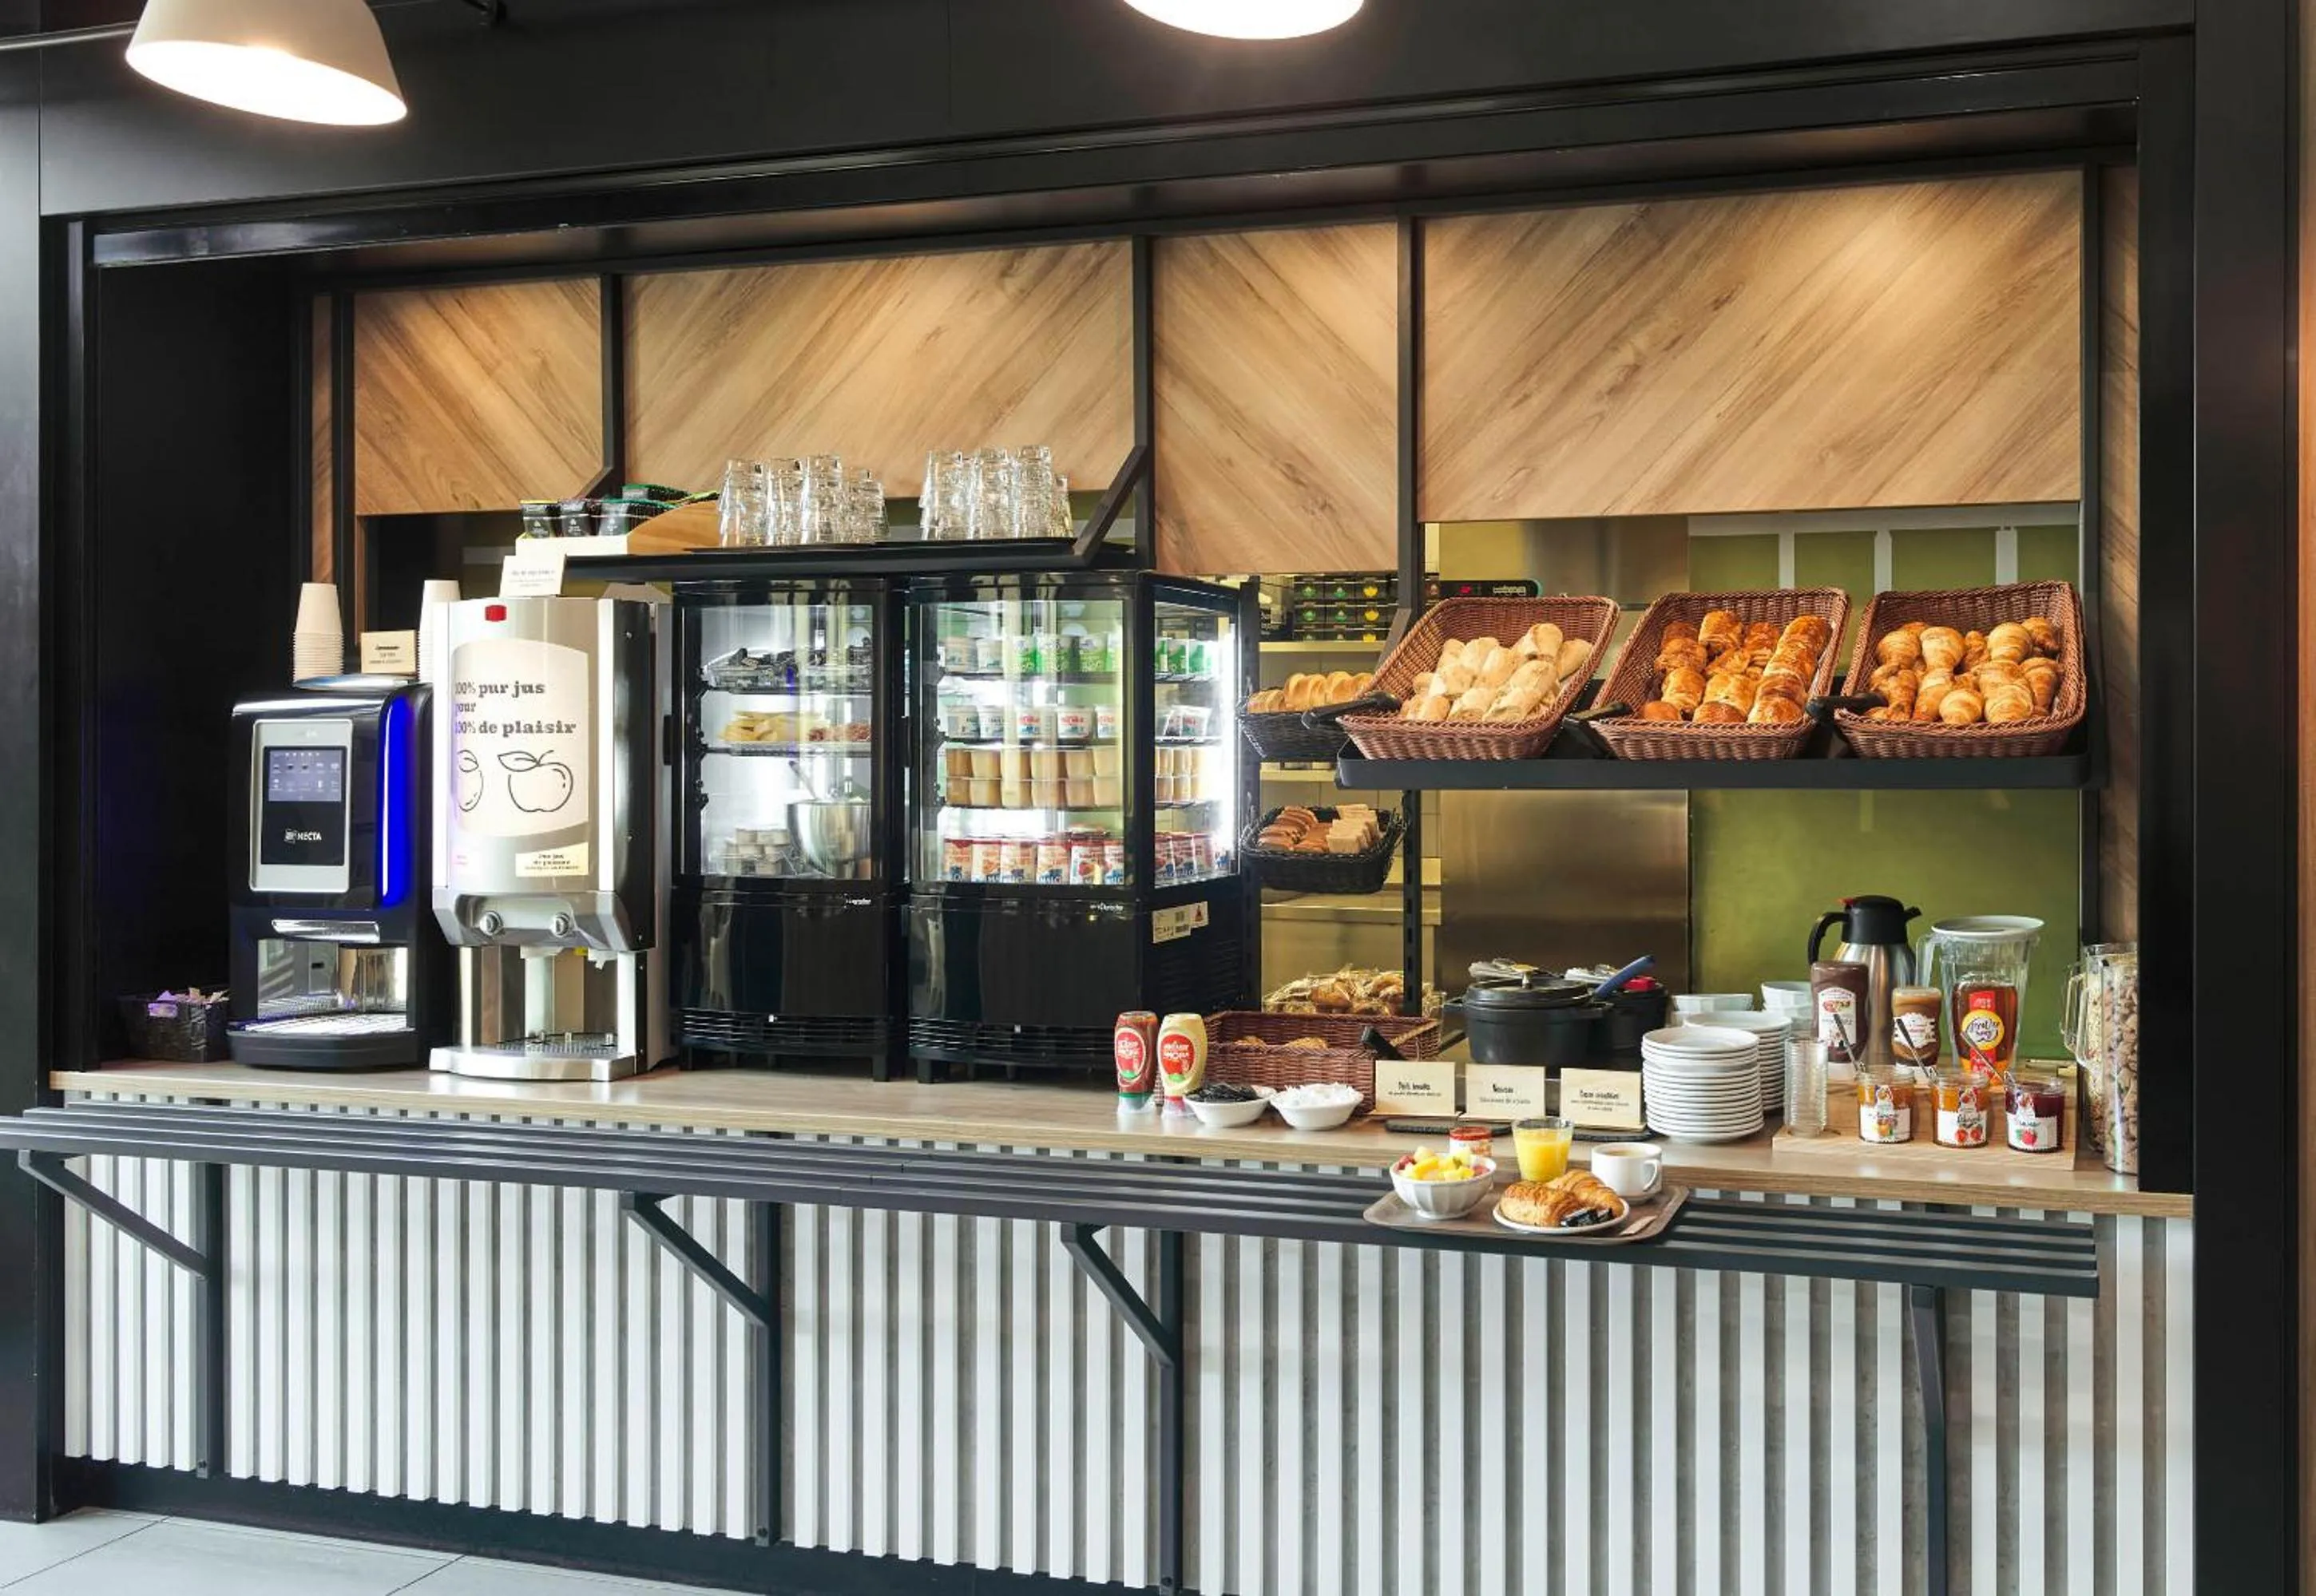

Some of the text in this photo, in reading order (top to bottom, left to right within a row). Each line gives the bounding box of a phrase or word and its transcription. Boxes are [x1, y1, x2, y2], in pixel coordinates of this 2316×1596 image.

[478, 683, 510, 698] pur
[511, 680, 546, 699] jus
[479, 720, 498, 735] de
[502, 720, 577, 738] plaisir
